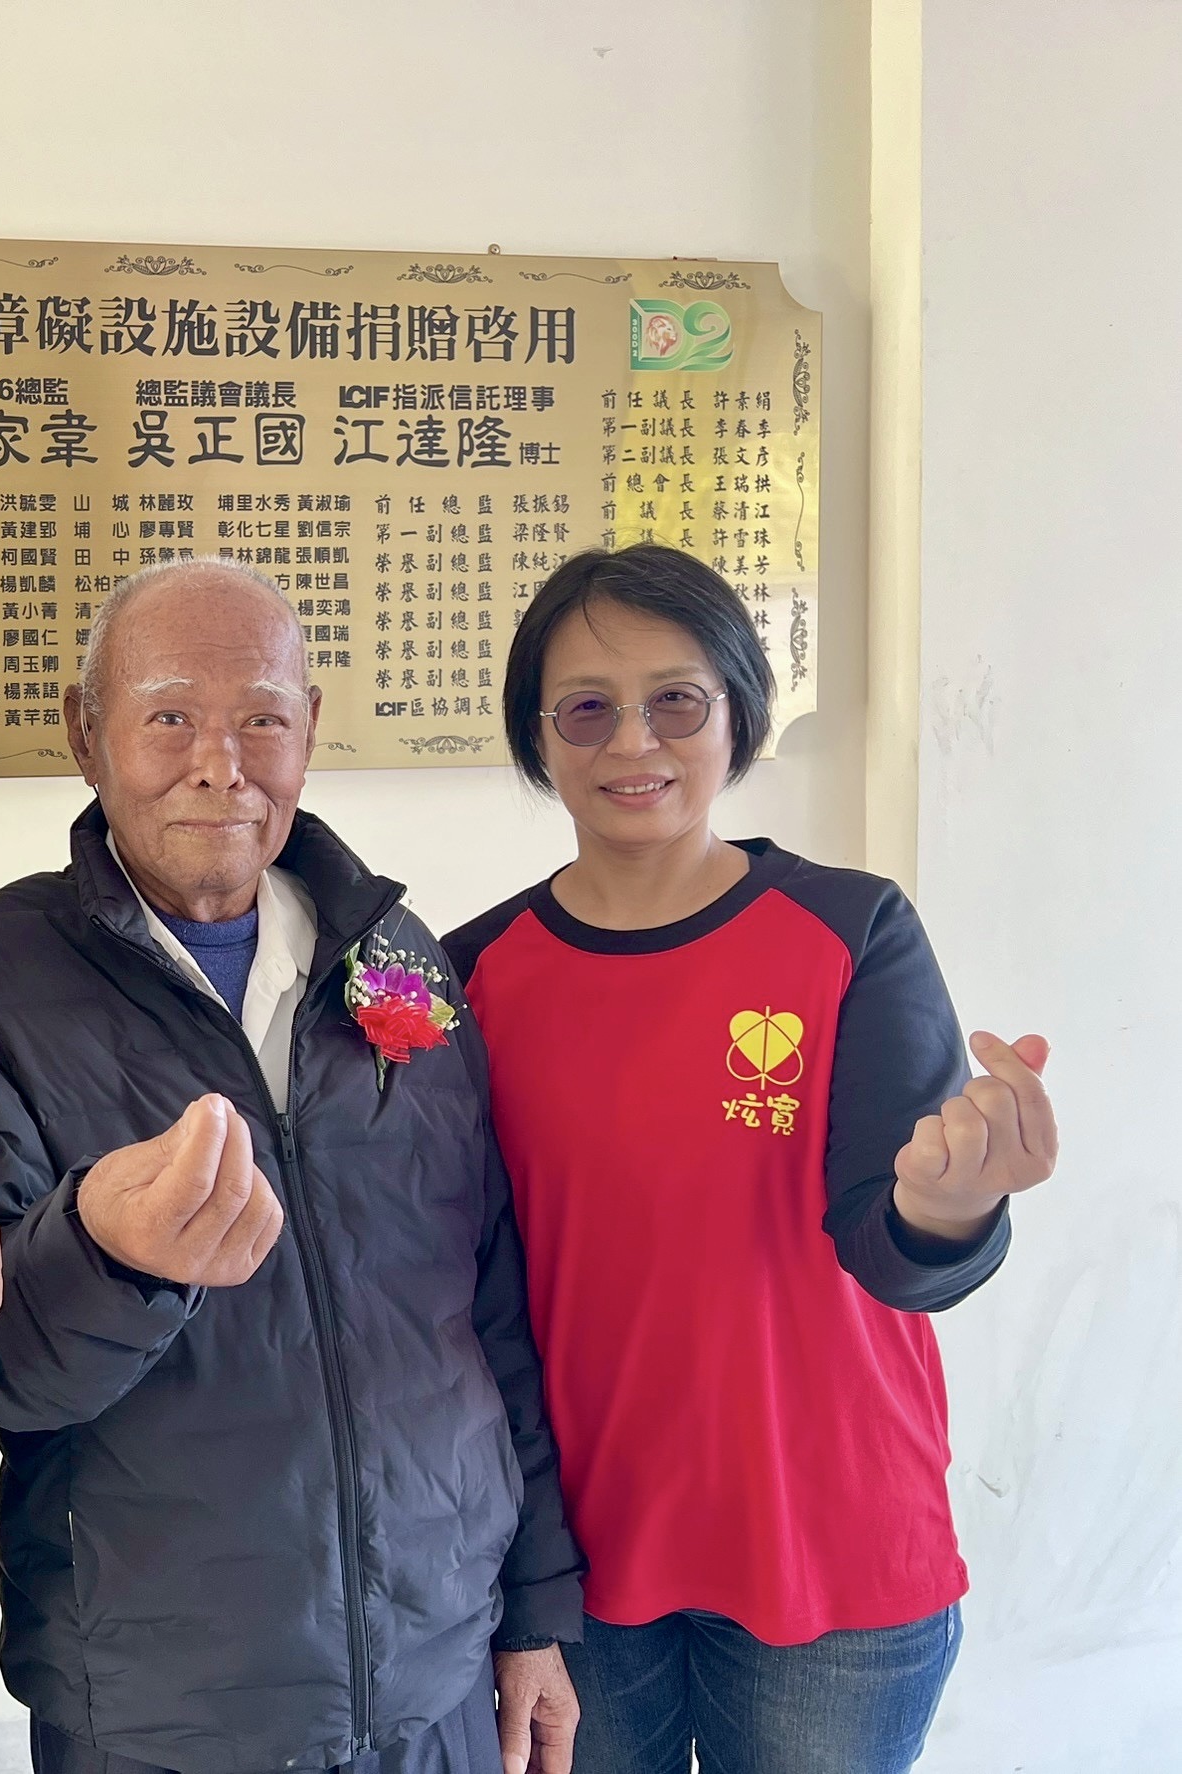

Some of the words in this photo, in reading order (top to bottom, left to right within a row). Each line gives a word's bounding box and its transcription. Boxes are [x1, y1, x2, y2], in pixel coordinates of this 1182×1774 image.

[136, 380, 297, 409] 總監議會議長
[601, 388, 696, 410] 前任議長
[602, 417, 696, 438] 第一副議長
[128, 410, 306, 468] 吳正國
[334, 415, 512, 468] 江達隆
[518, 442, 561, 466] 博士
[602, 445, 696, 466] 第二副議長
[601, 472, 696, 494] 前總會長
[0, 493, 57, 512] 洪毓雯
[138, 493, 194, 512] 林麗玫
[218, 494, 291, 512] 埔里水秀
[297, 494, 351, 512] 黃淑瑜
[375, 494, 493, 515] 前任總監
[712, 500, 771, 521] 蔡清江
[139, 520, 194, 539] 廖專賢
[218, 521, 291, 538] 彰化七星
[298, 521, 351, 538] 劉信宗
[375, 523, 493, 545] 第一副總監
[712, 528, 771, 549] 許雪珠
[1, 548, 58, 566] 柯國賢
[296, 547, 349, 564] 張順凱
[375, 552, 493, 574] 榮譽副總監
[0, 575, 57, 593] 楊凱麟
[296, 573, 349, 591] 陳世昌
[375, 581, 493, 603] 榮譽副總監
[2, 602, 58, 620] 黃小菁
[298, 599, 351, 616] 楊奕鴻
[375, 610, 493, 632] 榮譽副總監
[3, 629, 58, 647] 廖國仁
[375, 639, 493, 661] 榮譽副總監
[4, 656, 59, 674] 周玉卿
[375, 668, 493, 690] 榮譽副總監
[4, 682, 59, 700] 楊燕語
[722, 1092, 800, 1136] 炫寬
